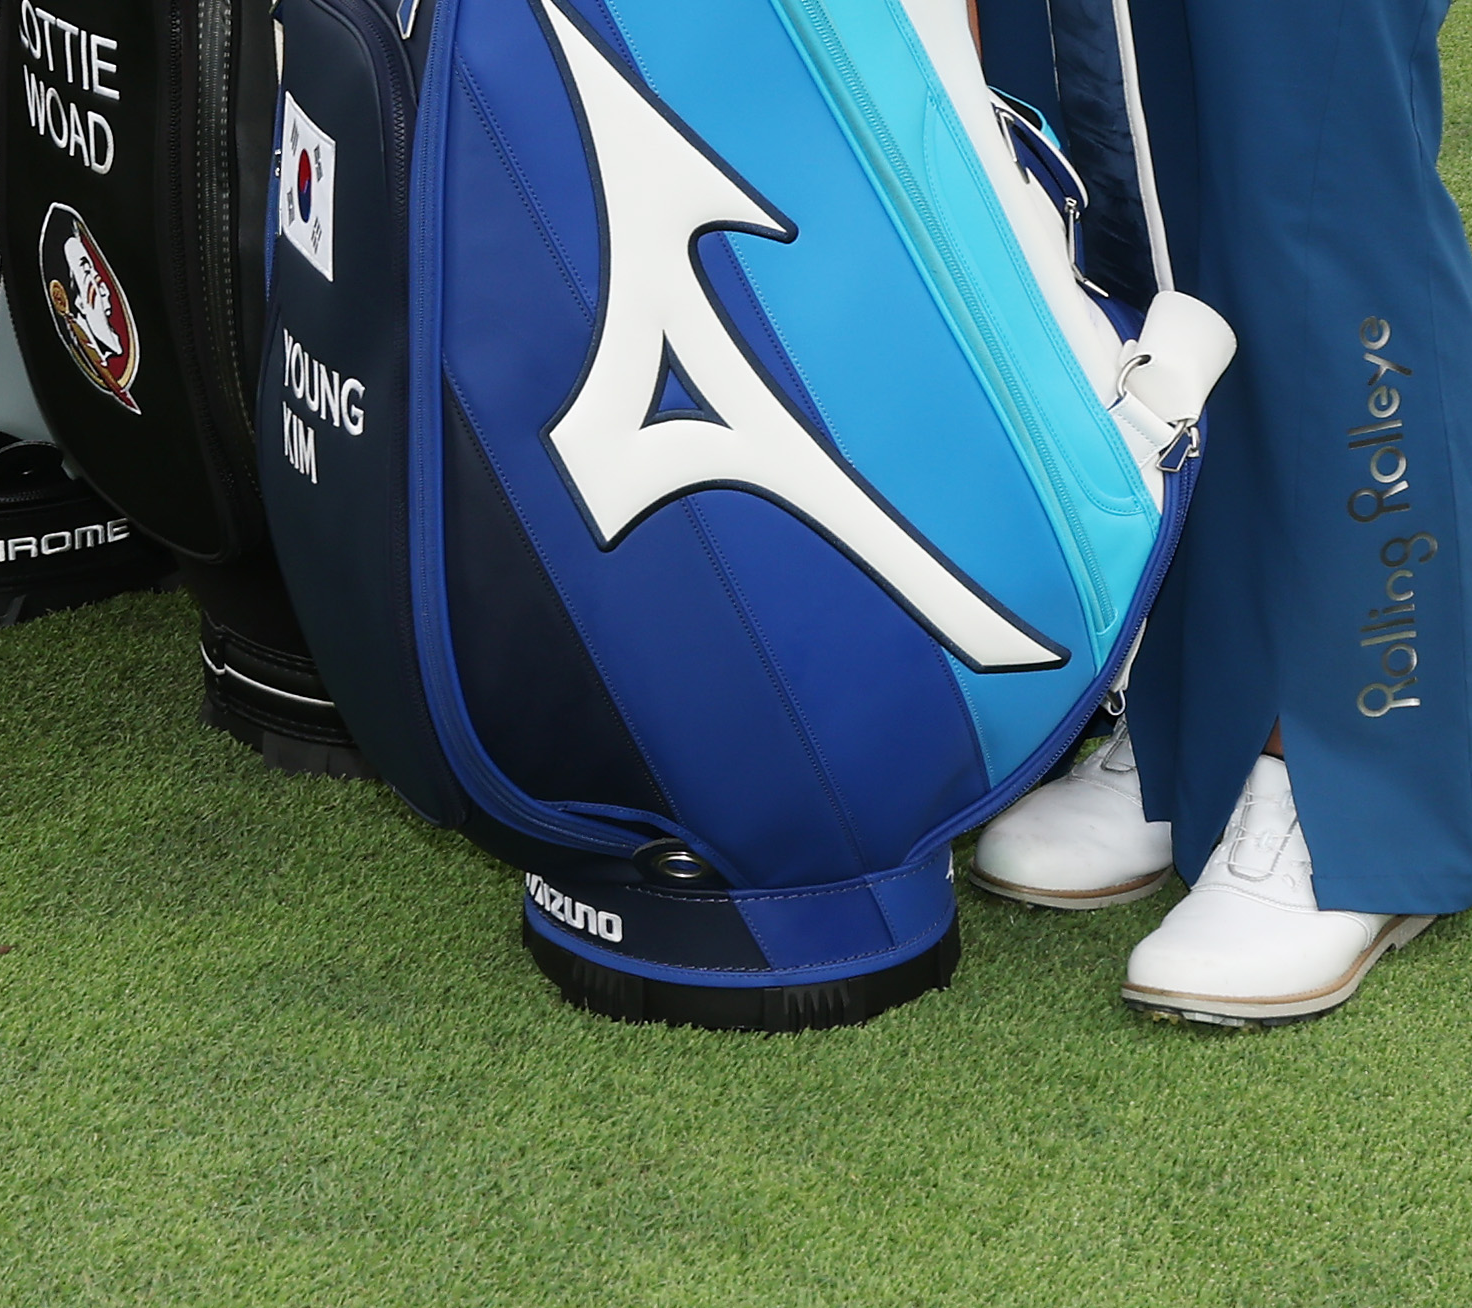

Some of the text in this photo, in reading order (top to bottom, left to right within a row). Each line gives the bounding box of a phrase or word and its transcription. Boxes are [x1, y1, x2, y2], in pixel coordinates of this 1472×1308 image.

[19, 0, 121, 102] OTTIE
[22, 65, 114, 176] WOAD
[282, 327, 366, 438] YOUNG
[281, 400, 318, 485] KIM
[1347, 315, 1439, 718] Rolling Rolleye
